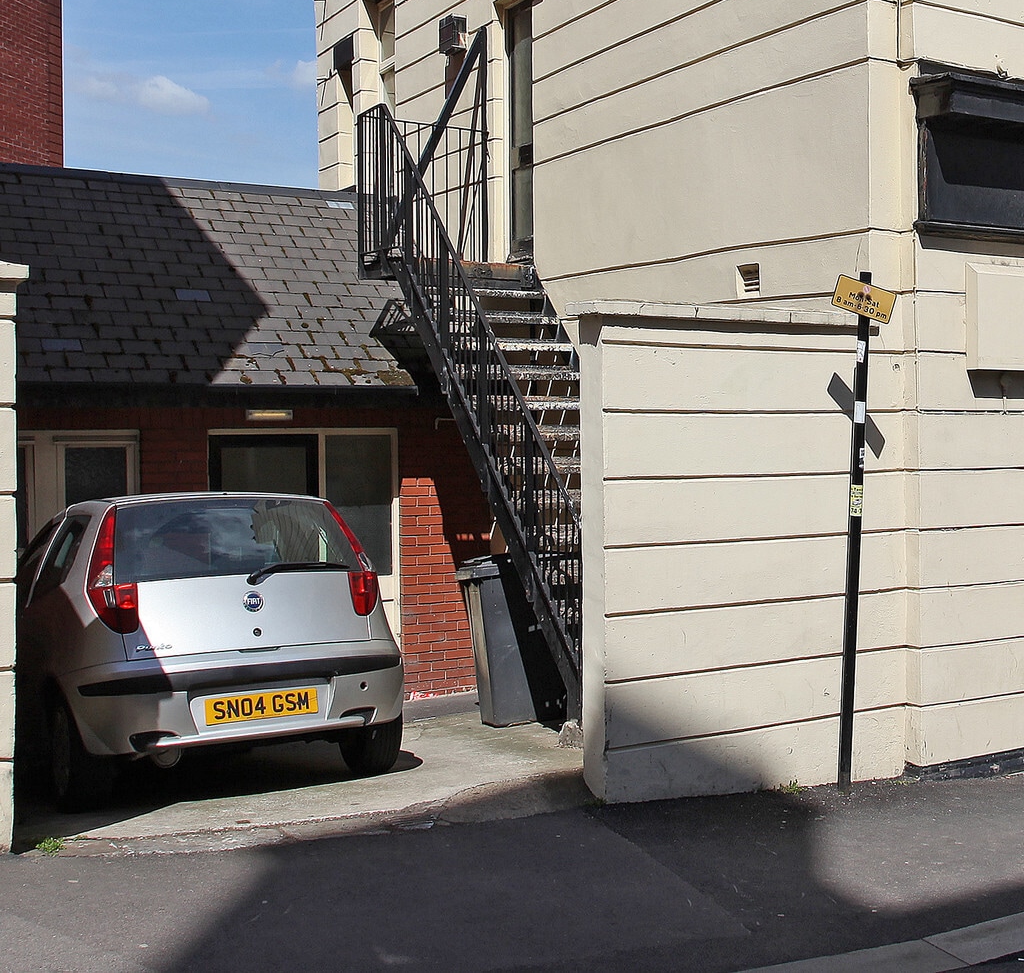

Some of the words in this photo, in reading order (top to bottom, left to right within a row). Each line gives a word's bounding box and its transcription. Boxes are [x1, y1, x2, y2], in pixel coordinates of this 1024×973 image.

[836, 295, 842, 303] 8
[875, 311, 887, 320] pm
[247, 597, 260, 606] FIAT
[213, 695, 266, 720] SN04
[272, 691, 310, 714] GSM
